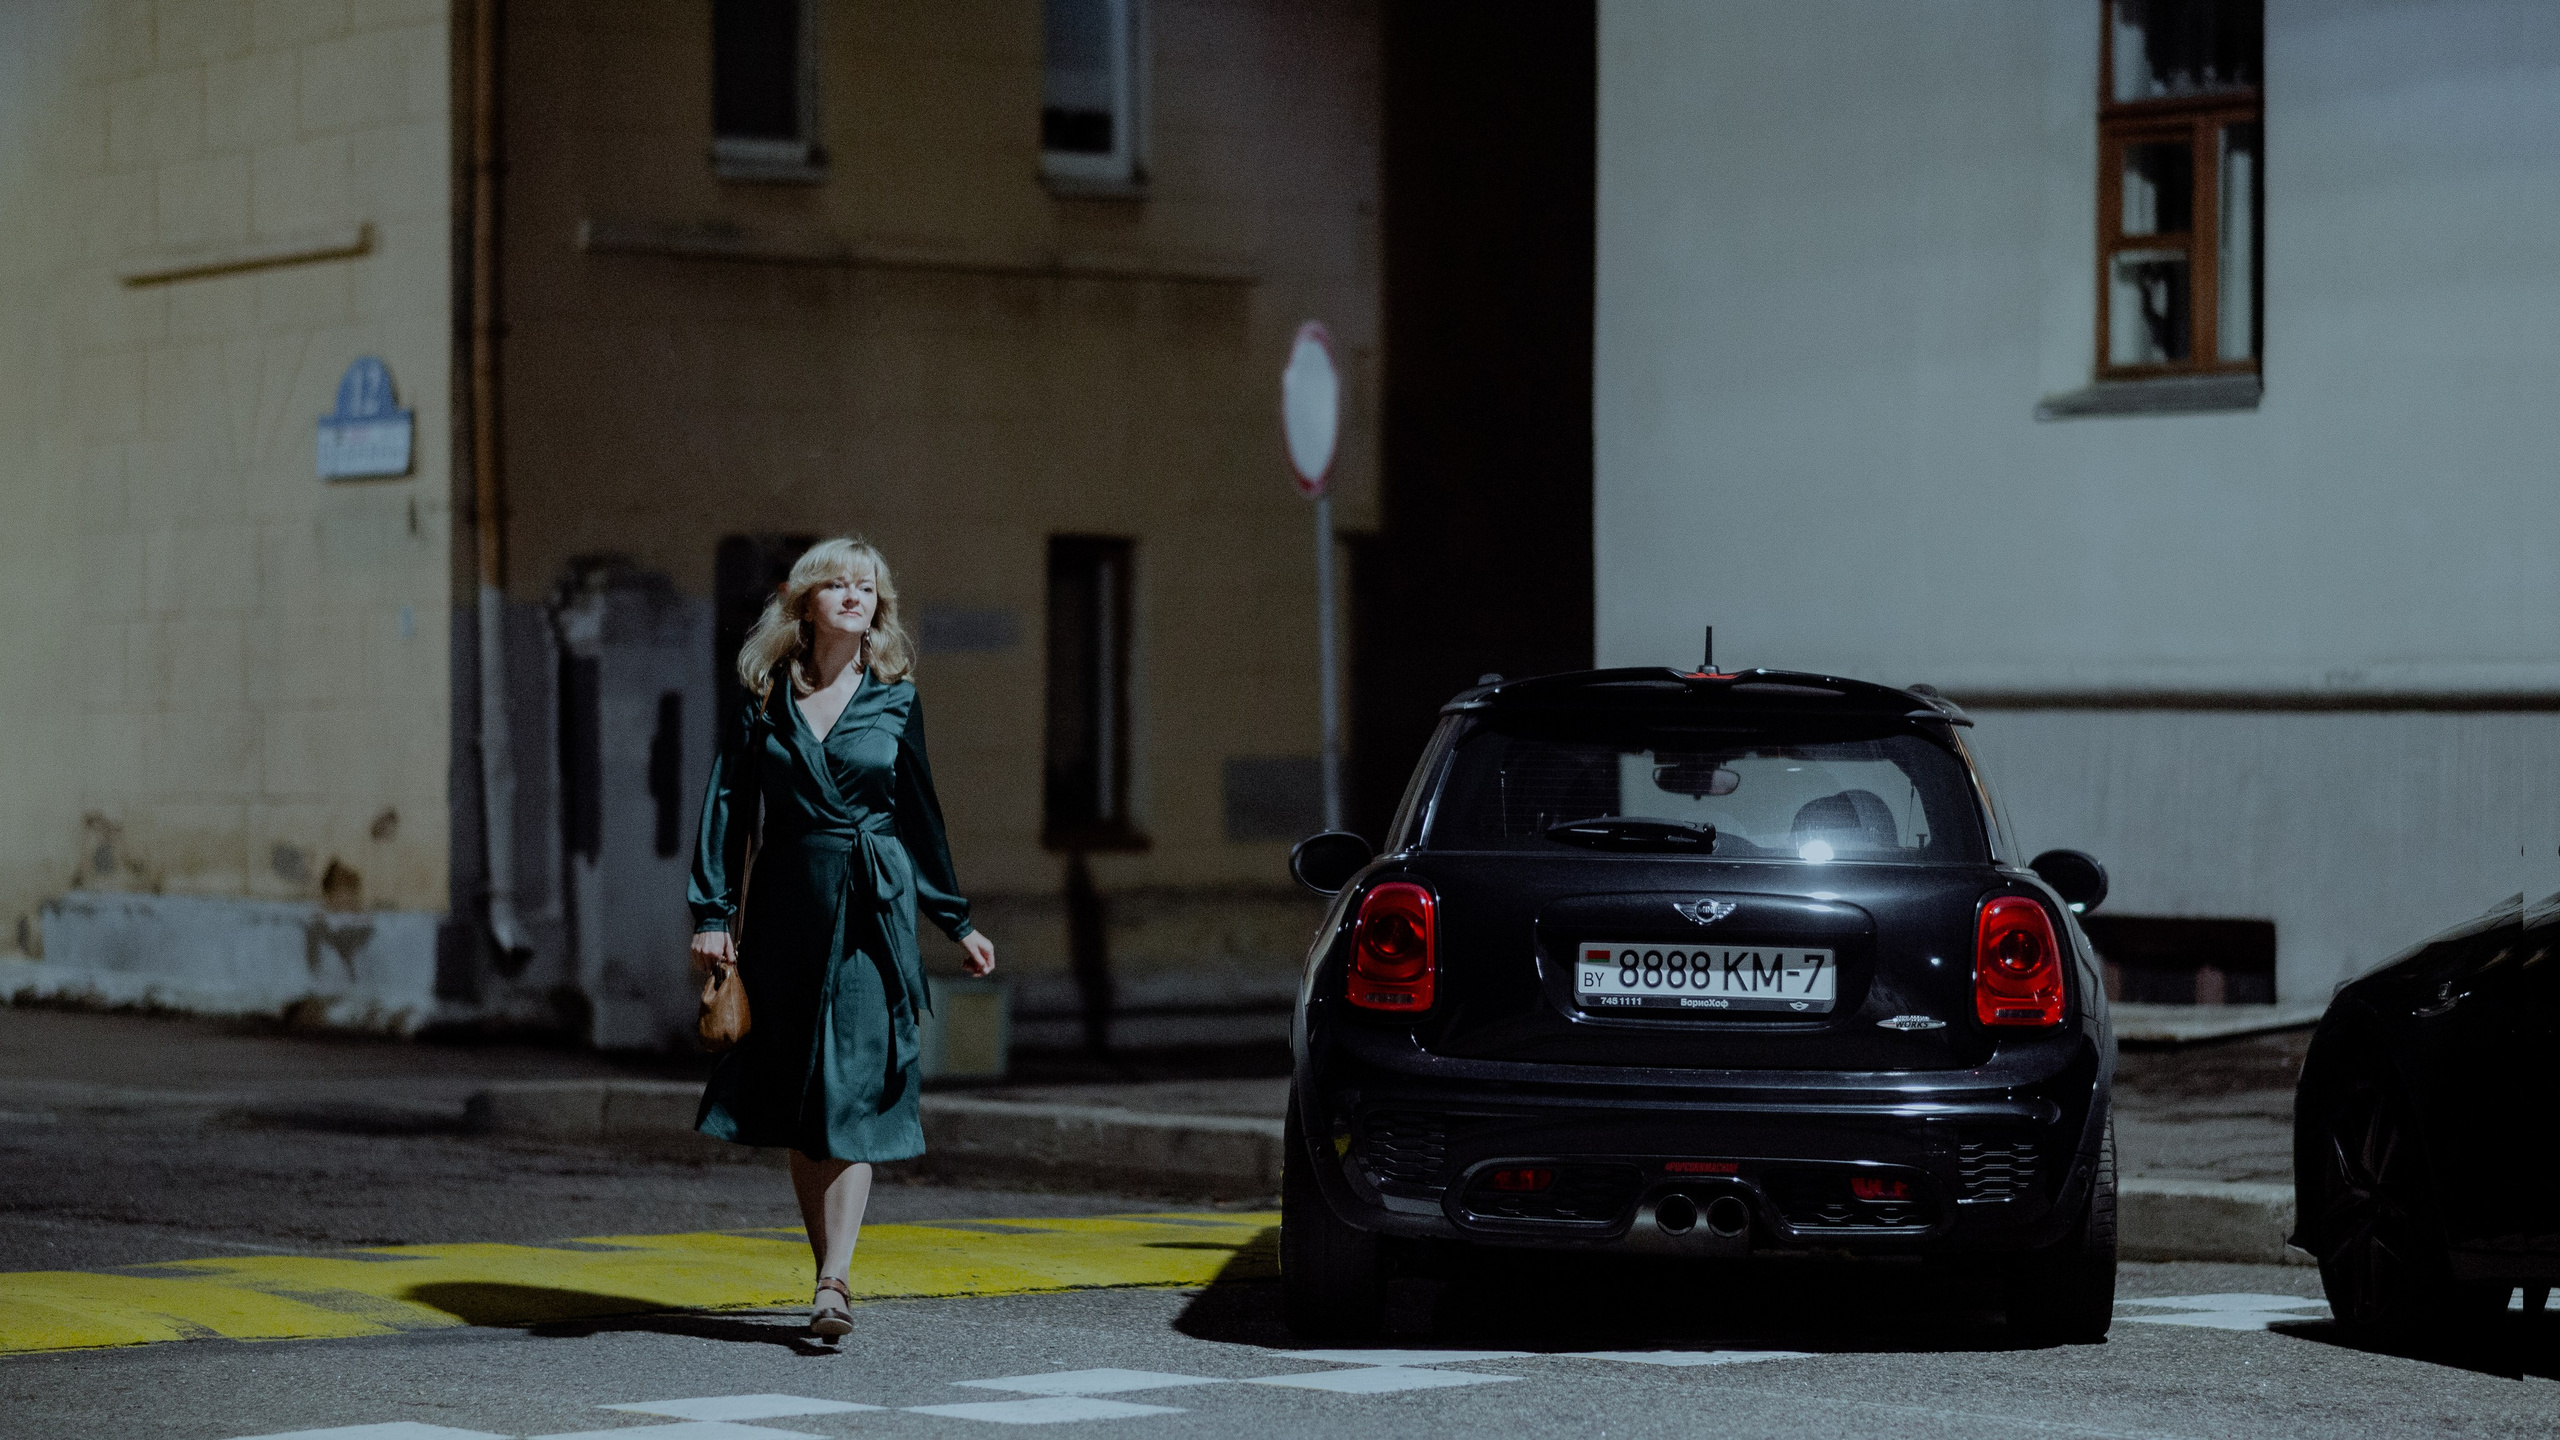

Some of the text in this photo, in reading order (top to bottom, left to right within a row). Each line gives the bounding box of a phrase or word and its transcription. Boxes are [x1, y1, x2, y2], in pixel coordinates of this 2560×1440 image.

[1697, 907, 1715, 916] MINI
[1584, 950, 1825, 993] BY 8888 KM-7
[1680, 998, 1729, 1009] БорисХоф
[1895, 1021, 1928, 1029] WORKS
